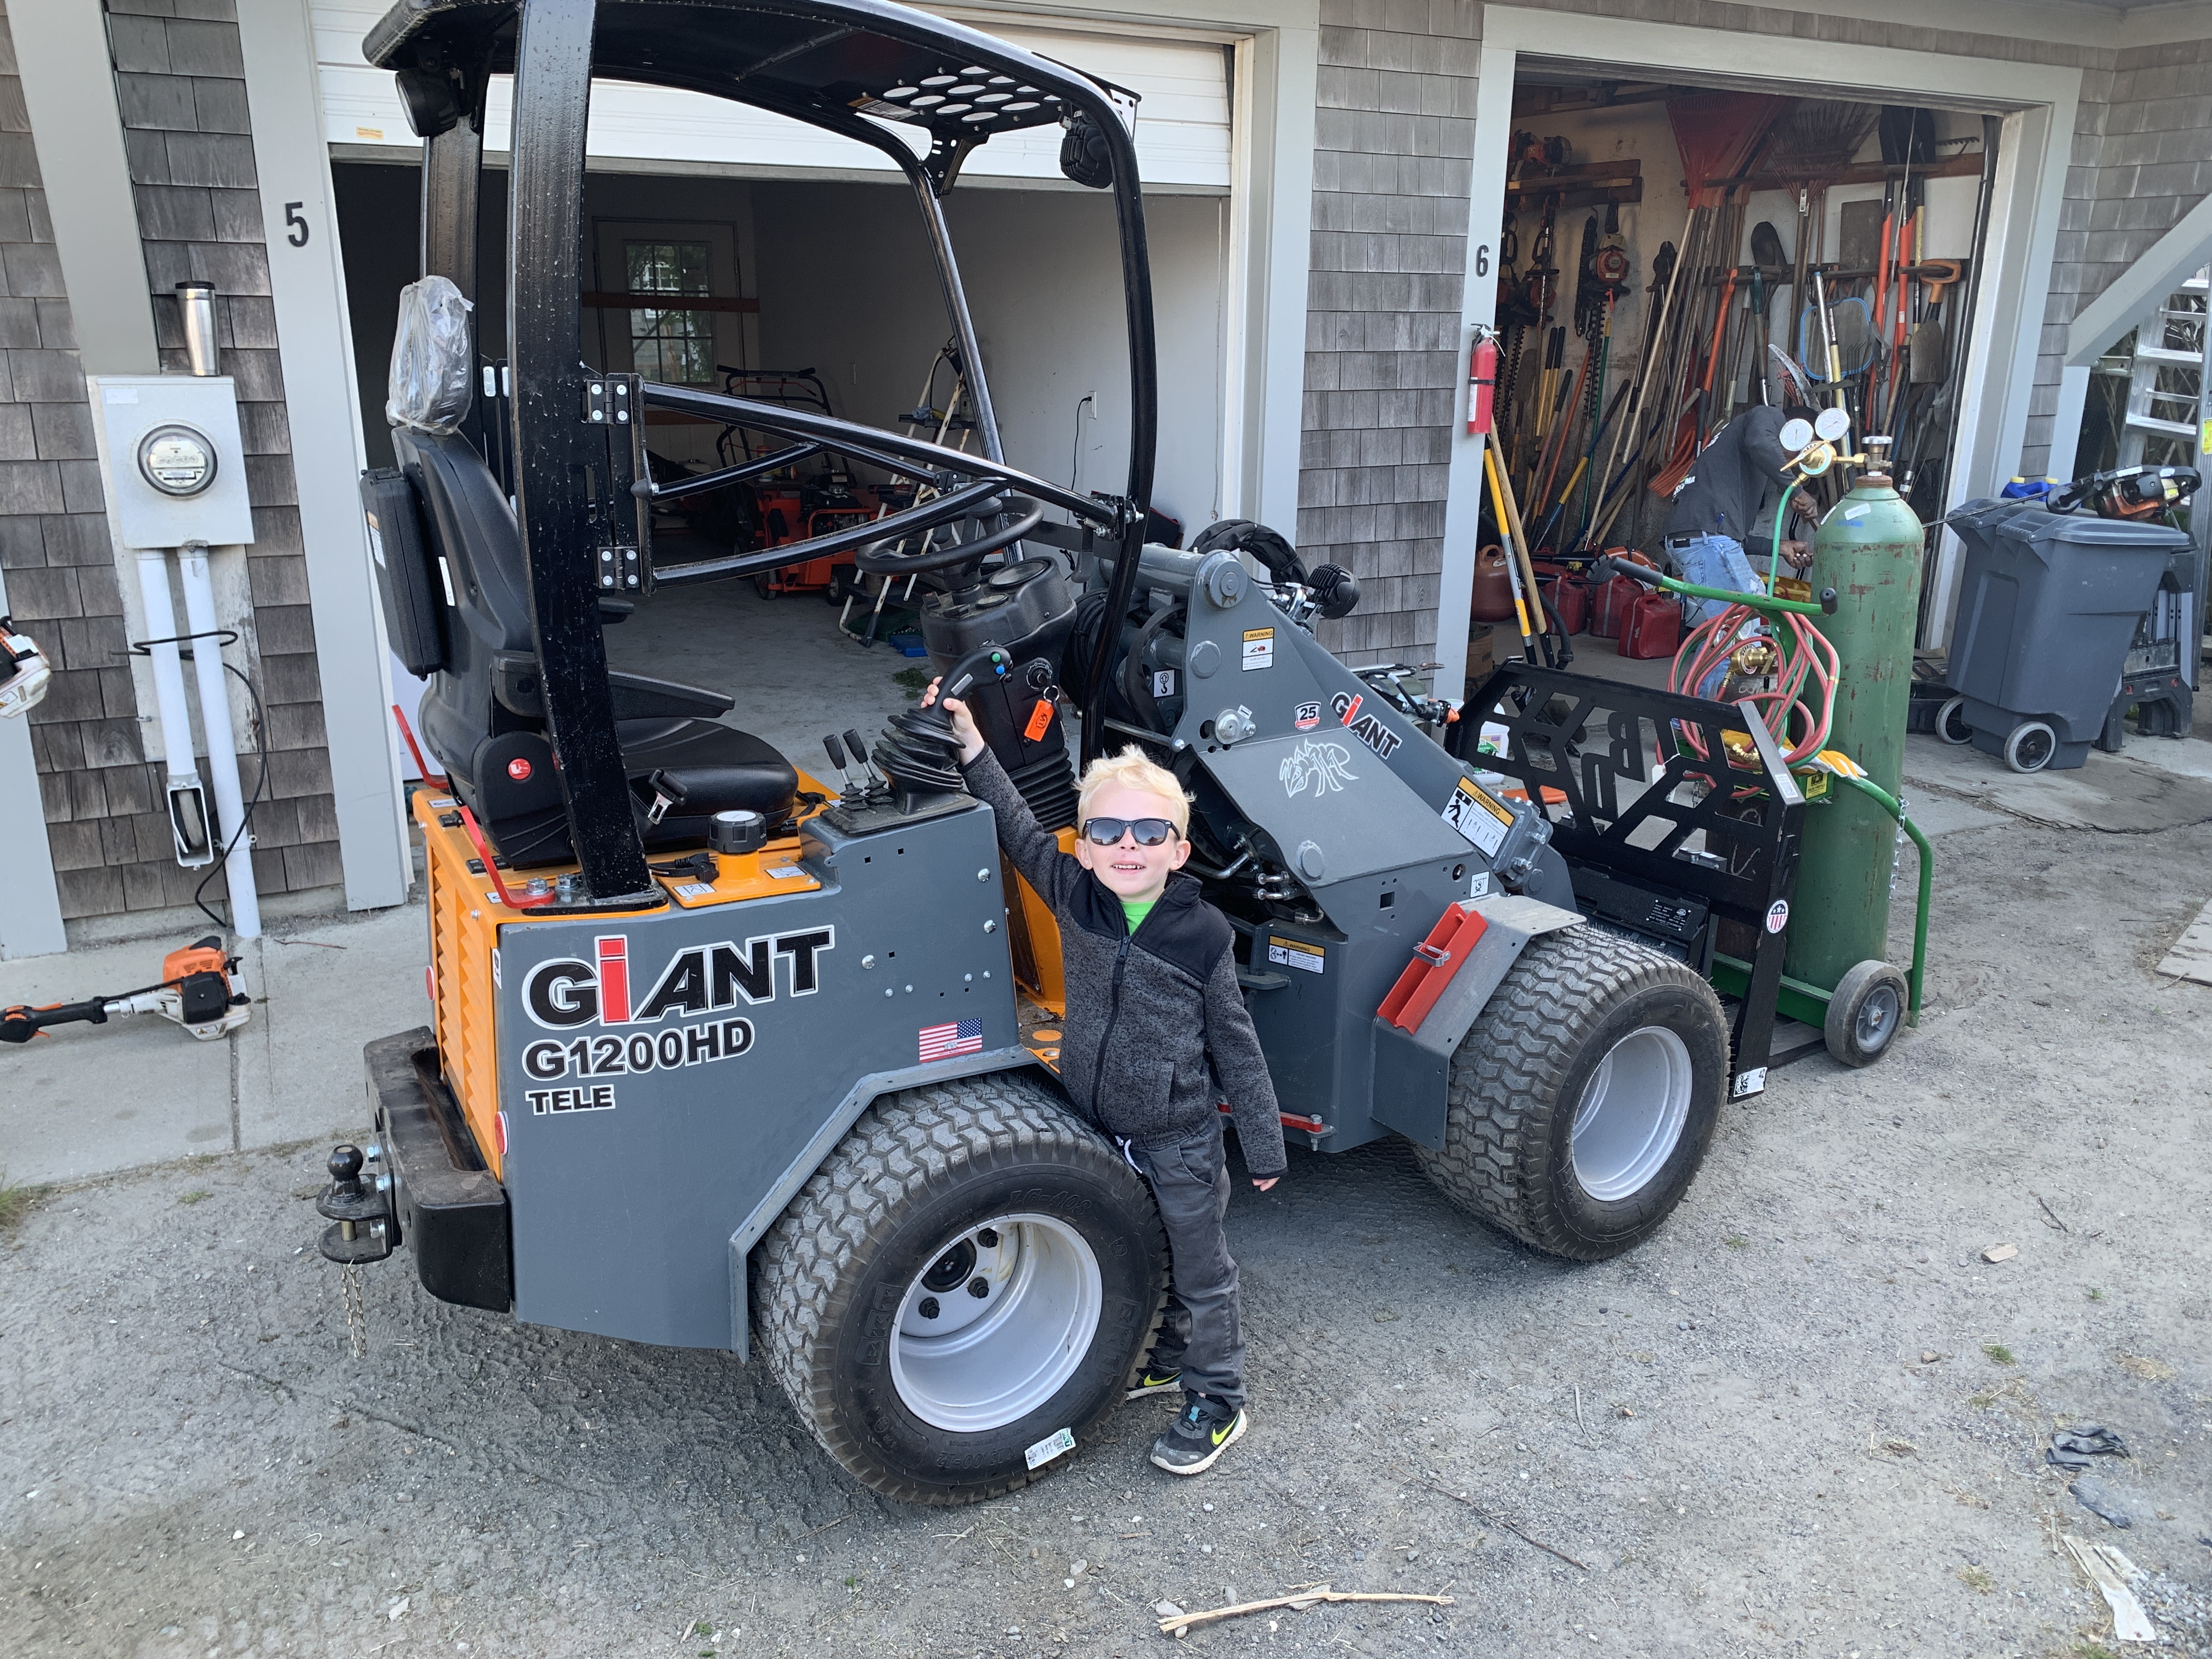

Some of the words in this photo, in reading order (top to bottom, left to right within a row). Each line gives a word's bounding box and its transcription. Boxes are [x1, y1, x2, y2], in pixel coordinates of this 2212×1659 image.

[285, 202, 309, 247] 5
[1476, 245, 1488, 276] 6
[1300, 706, 1316, 720] 25
[1477, 794, 1500, 815] WARNING
[1289, 944, 1310, 952] WARNING
[522, 1017, 755, 1081] G1200HD
[525, 1084, 616, 1115] TELE
[1008, 1188, 1091, 1215] LG-408
[856, 1282, 904, 1366] BKT
